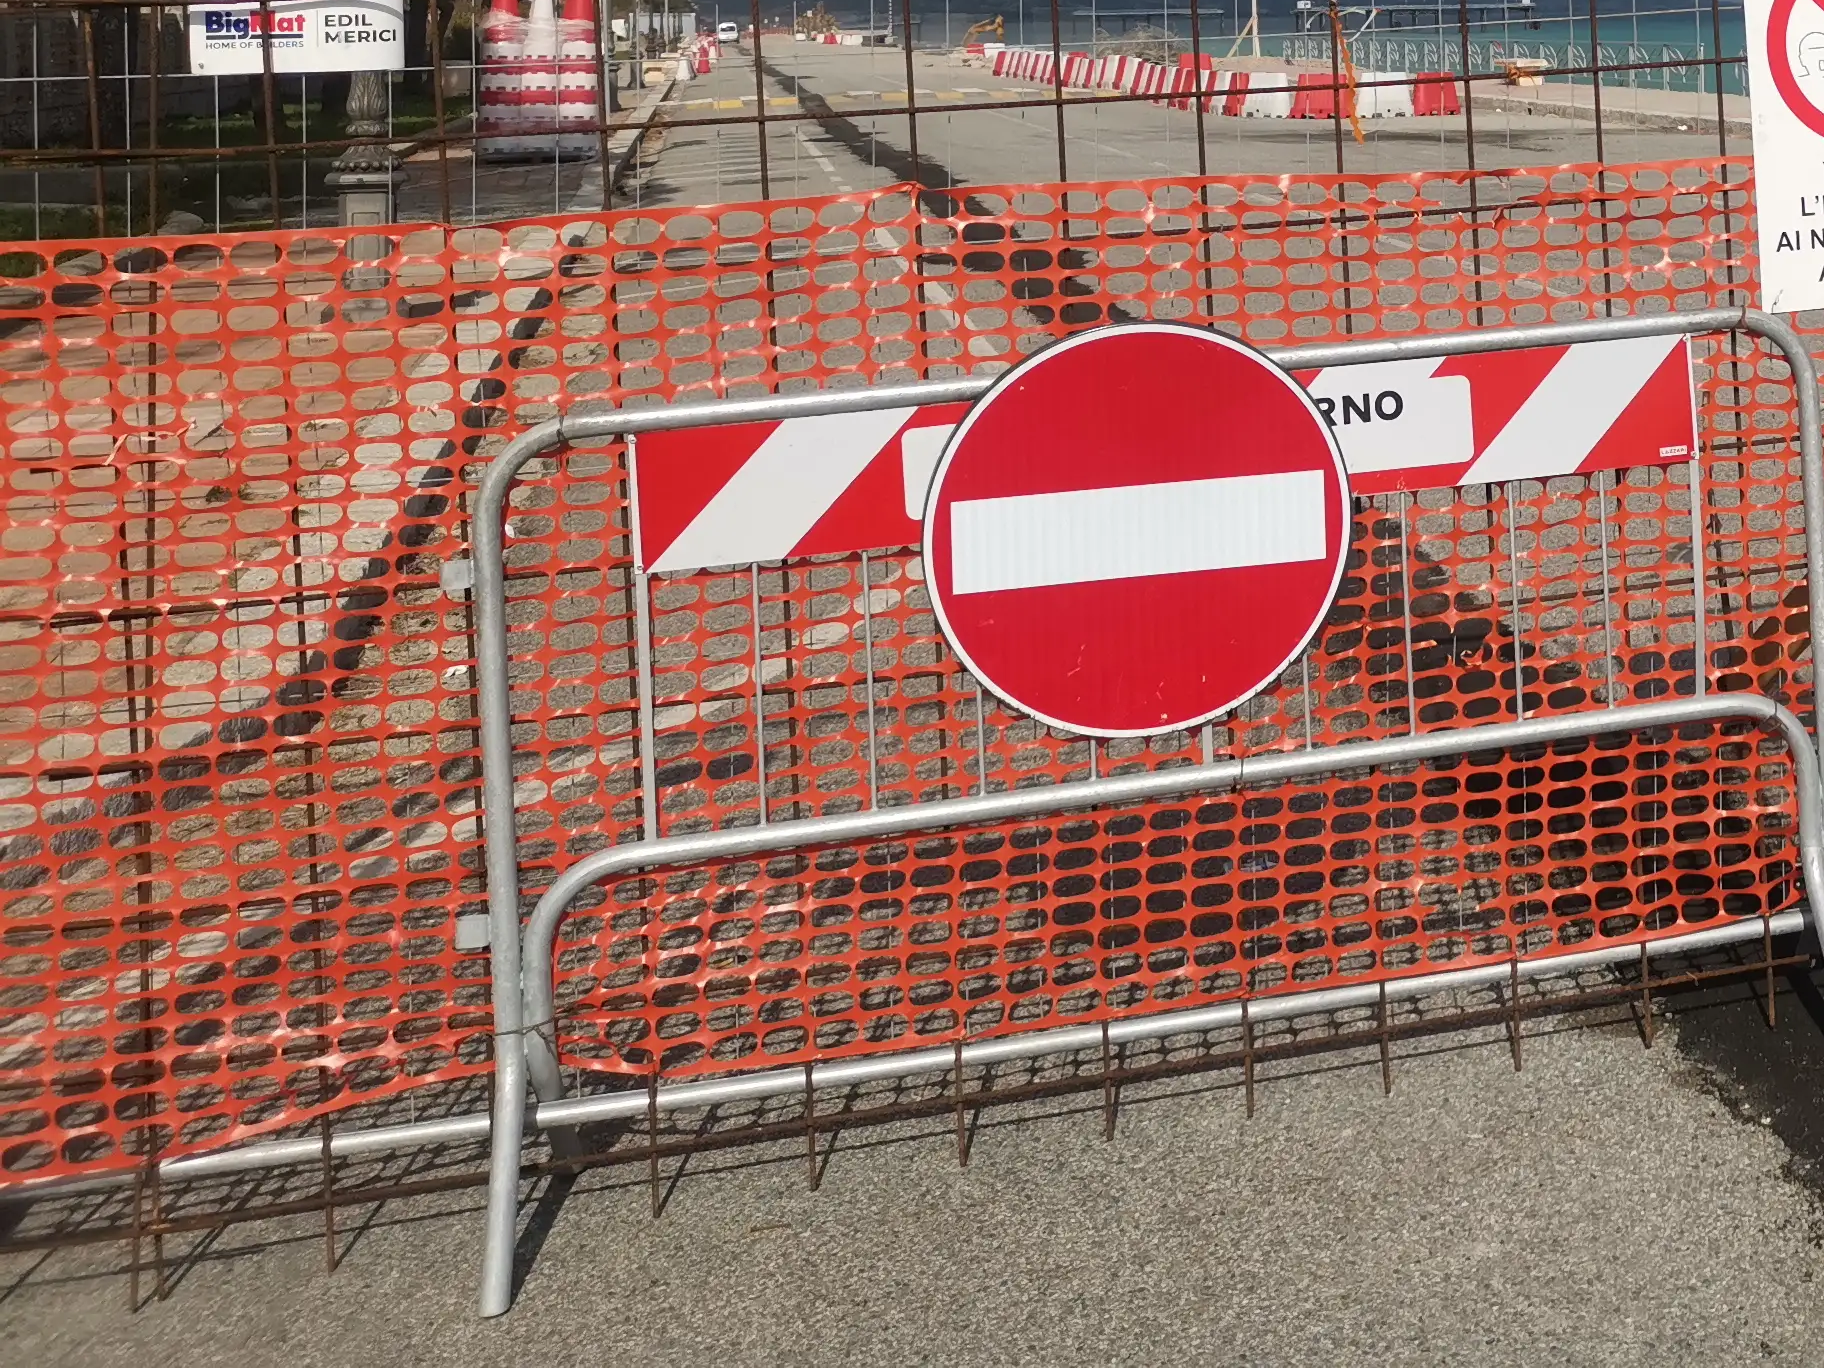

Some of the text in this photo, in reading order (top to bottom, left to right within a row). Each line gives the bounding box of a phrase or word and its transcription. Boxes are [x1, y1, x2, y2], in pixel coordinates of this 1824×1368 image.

[324, 14, 373, 28] EDIL
[324, 29, 397, 44] MERICI
[205, 40, 305, 49] HOME OF BILDERS
[1776, 230, 1801, 252] AI
